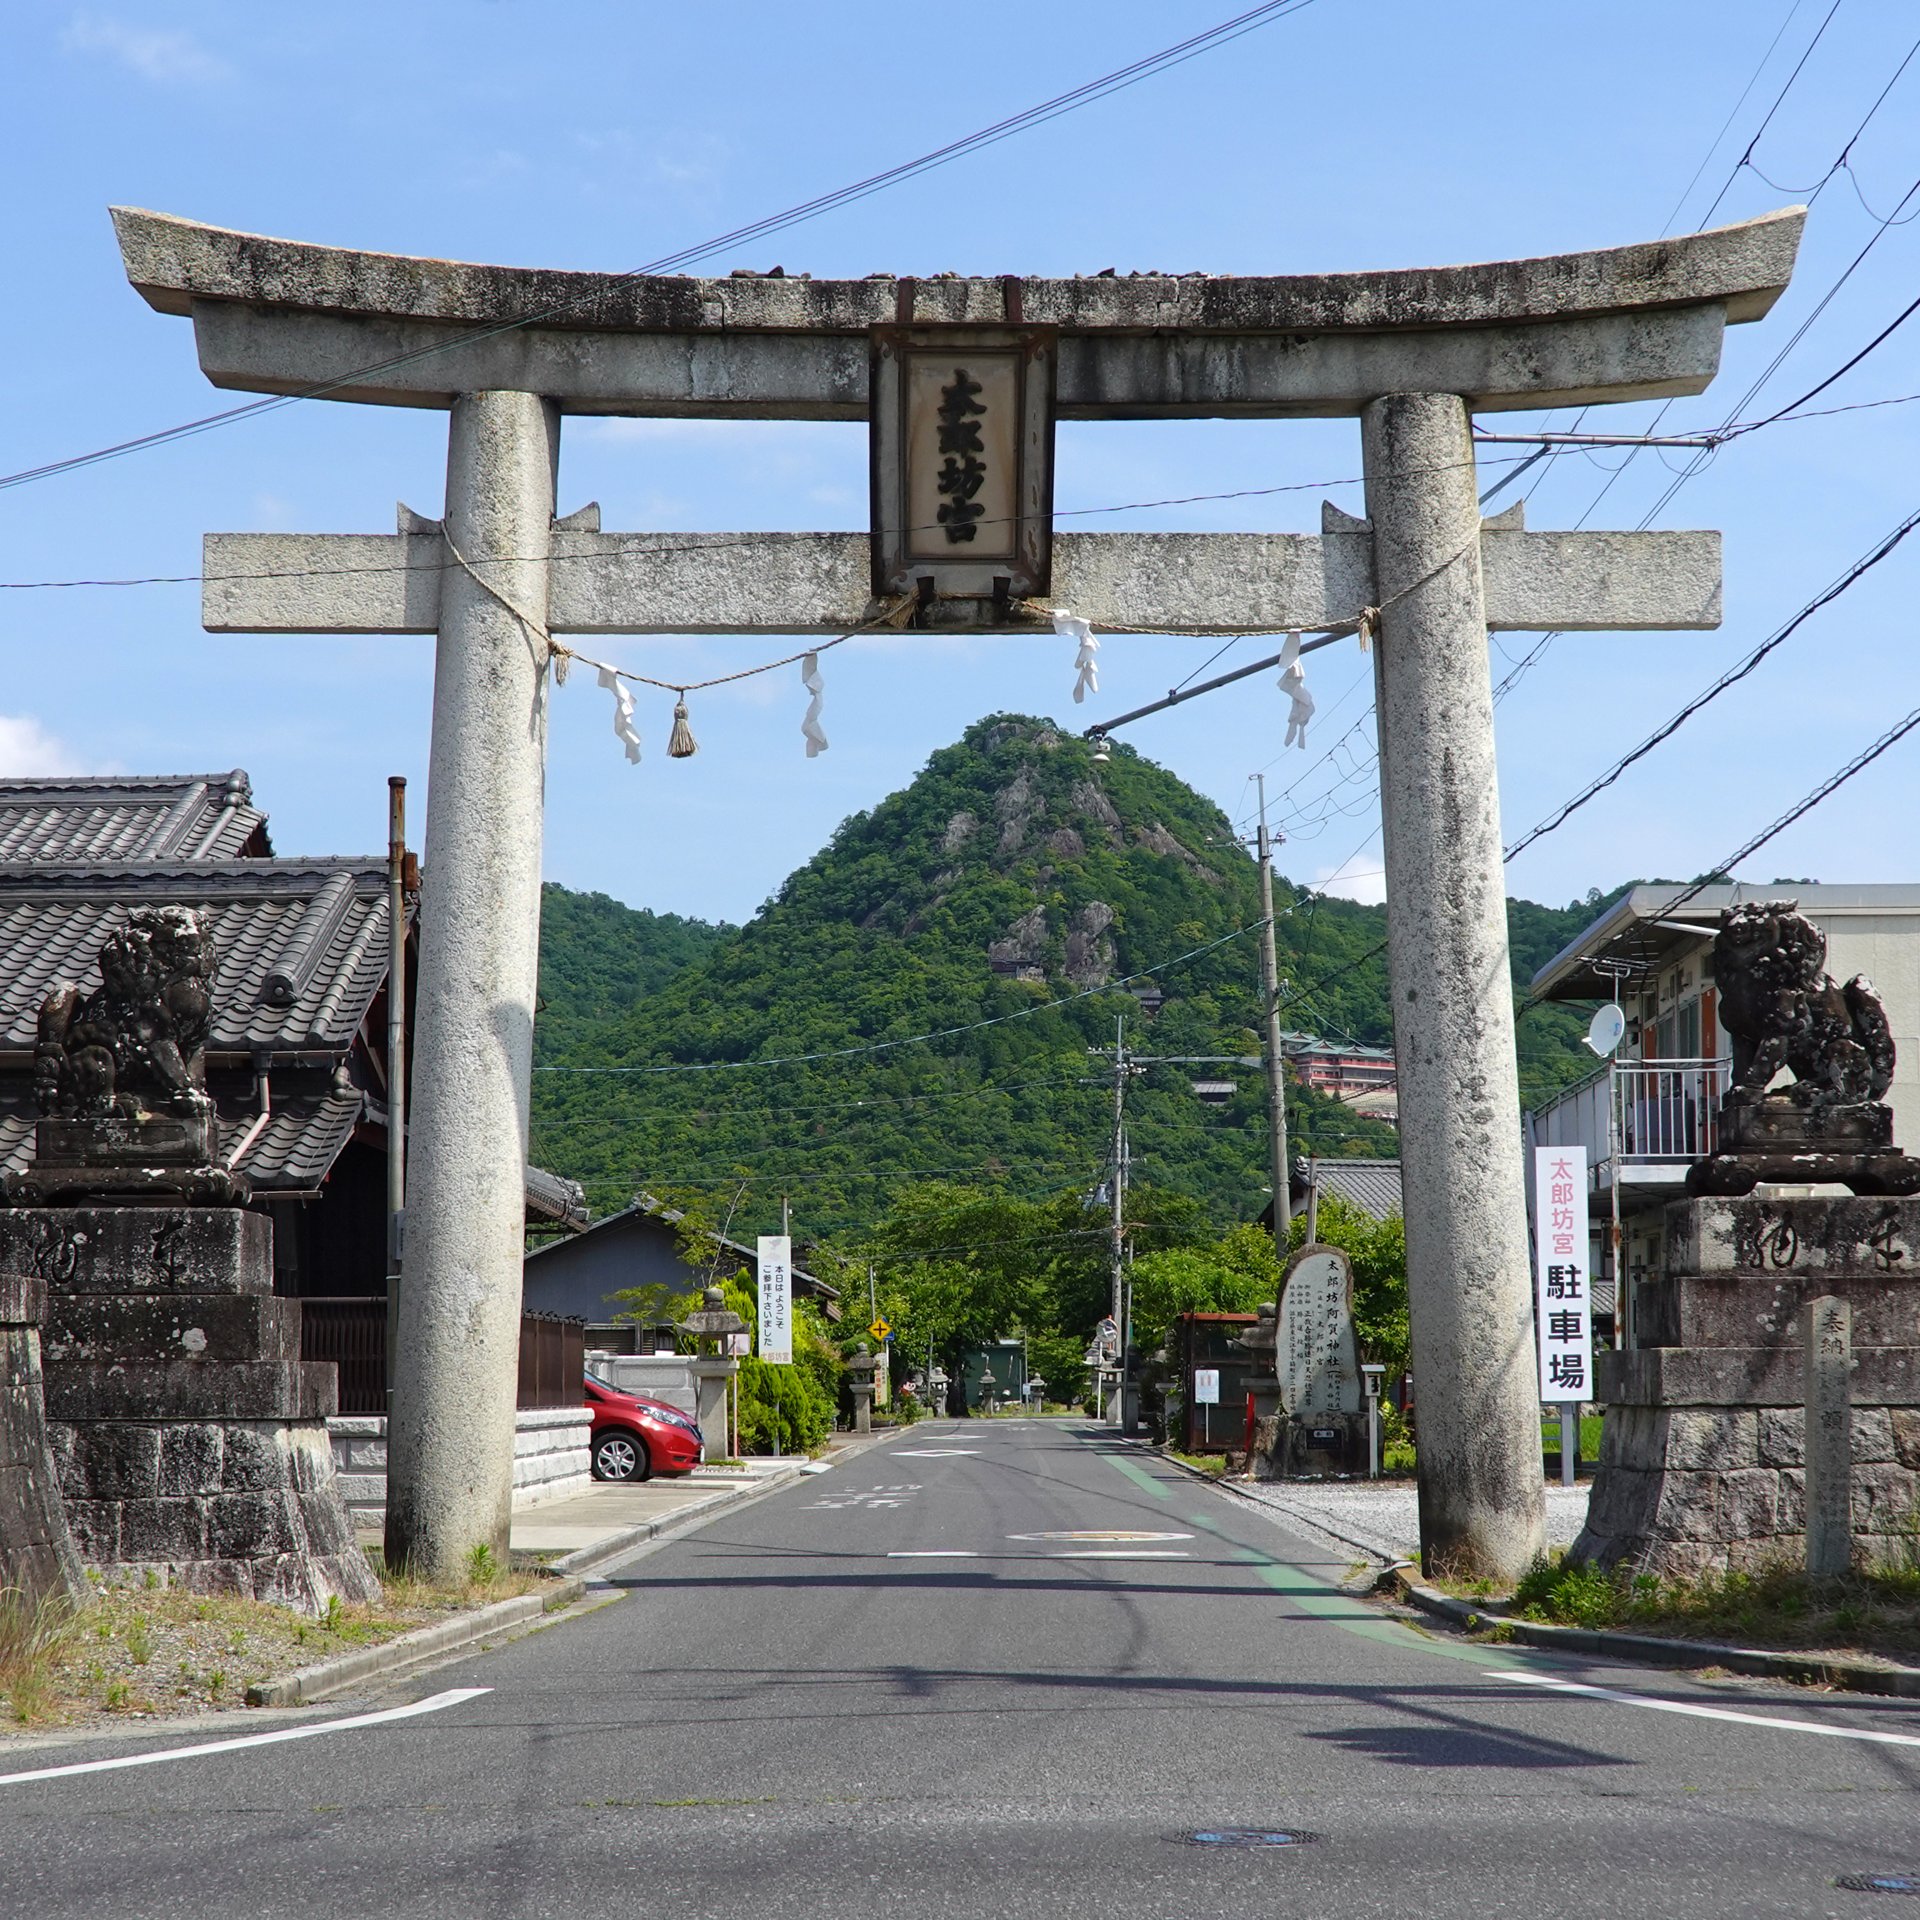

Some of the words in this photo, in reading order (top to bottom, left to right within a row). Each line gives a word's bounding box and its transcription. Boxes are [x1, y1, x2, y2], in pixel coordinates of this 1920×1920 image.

[937, 368, 987, 544] 太郎坊宮
[1550, 1158, 1575, 1255] 太郎坊宮
[1547, 1264, 1584, 1389] 駐車場
[1820, 1310, 1845, 1356] 奉納
